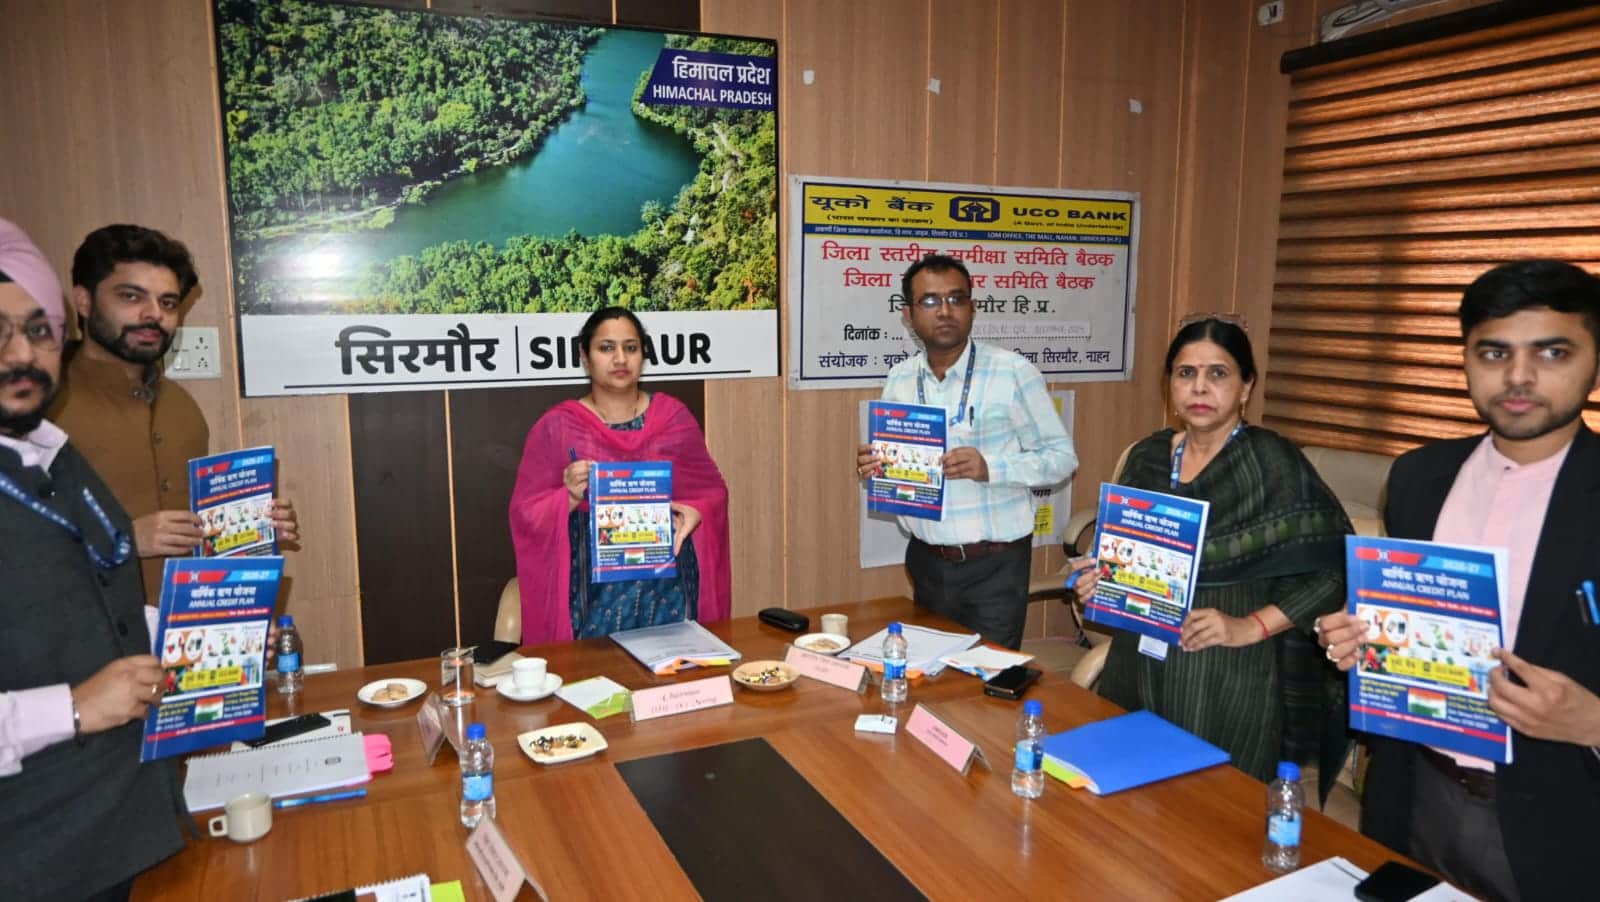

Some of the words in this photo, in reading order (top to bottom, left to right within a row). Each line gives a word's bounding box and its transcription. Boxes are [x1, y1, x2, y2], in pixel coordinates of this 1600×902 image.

[672, 56, 734, 82] हिमाचल
[736, 62, 771, 85] प्रदेश
[653, 85, 717, 102] HIMACHAL
[720, 89, 772, 105] PRADESH
[809, 195, 870, 211] यूको
[885, 196, 934, 212] बैंक
[1013, 207, 1060, 217] UCO
[1067, 210, 1127, 221] BANK
[822, 240, 871, 260] जिला
[1015, 247, 1068, 266] समिति
[1075, 248, 1115, 266] बैठक
[843, 267, 892, 287] जिला
[993, 270, 1049, 289] समिति
[1056, 272, 1096, 289] बैठक
[844, 324, 880, 341] दिनांक
[335, 323, 499, 375] सिरमौर
[1085, 351, 1110, 363] नाहन
[819, 351, 868, 368] संयोजक
[1121, 518, 1145, 529] ANNUAL
[1145, 523, 1165, 533] CREDIT
[1164, 527, 1179, 537] PLAN
[1381, 580, 1416, 592] ANNUAL
[1416, 585, 1446, 597] CREDIT
[1446, 588, 1470, 601] PLAN
[189, 600, 216, 609] ANNUAL
[216, 599, 239, 608] CREDIT
[239, 597, 255, 606] PLAN
